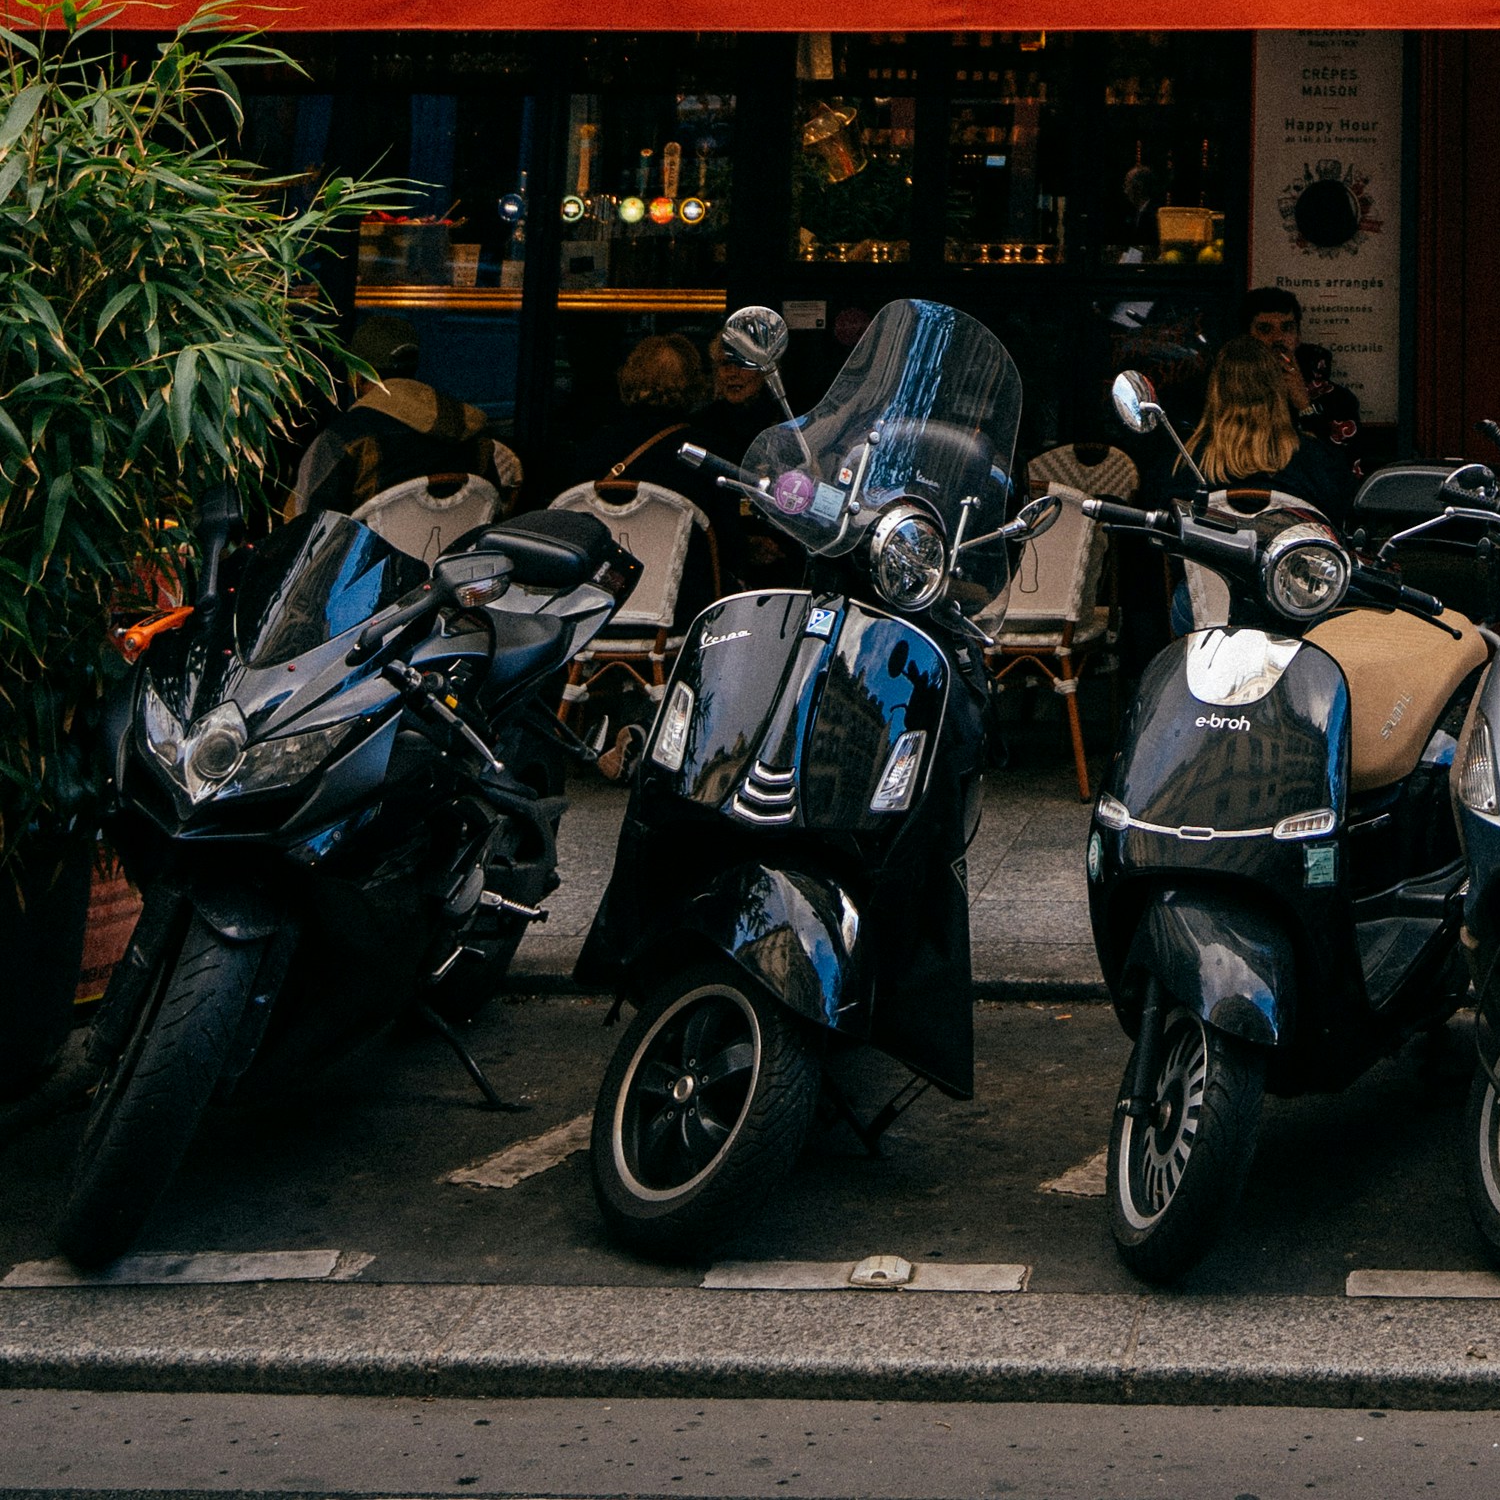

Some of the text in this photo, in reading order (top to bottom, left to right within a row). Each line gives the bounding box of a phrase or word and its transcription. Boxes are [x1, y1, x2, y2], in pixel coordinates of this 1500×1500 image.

[1302, 67, 1358, 80] CRÊPES
[1302, 85, 1358, 97] MAISON
[1285, 117, 1378, 133] Happy Hour
[1276, 276, 1384, 290] Rhums arrangés
[1330, 342, 1383, 353] Cocktails
[699, 630, 752, 649] Vespa
[1195, 713, 1251, 732] e-broh
